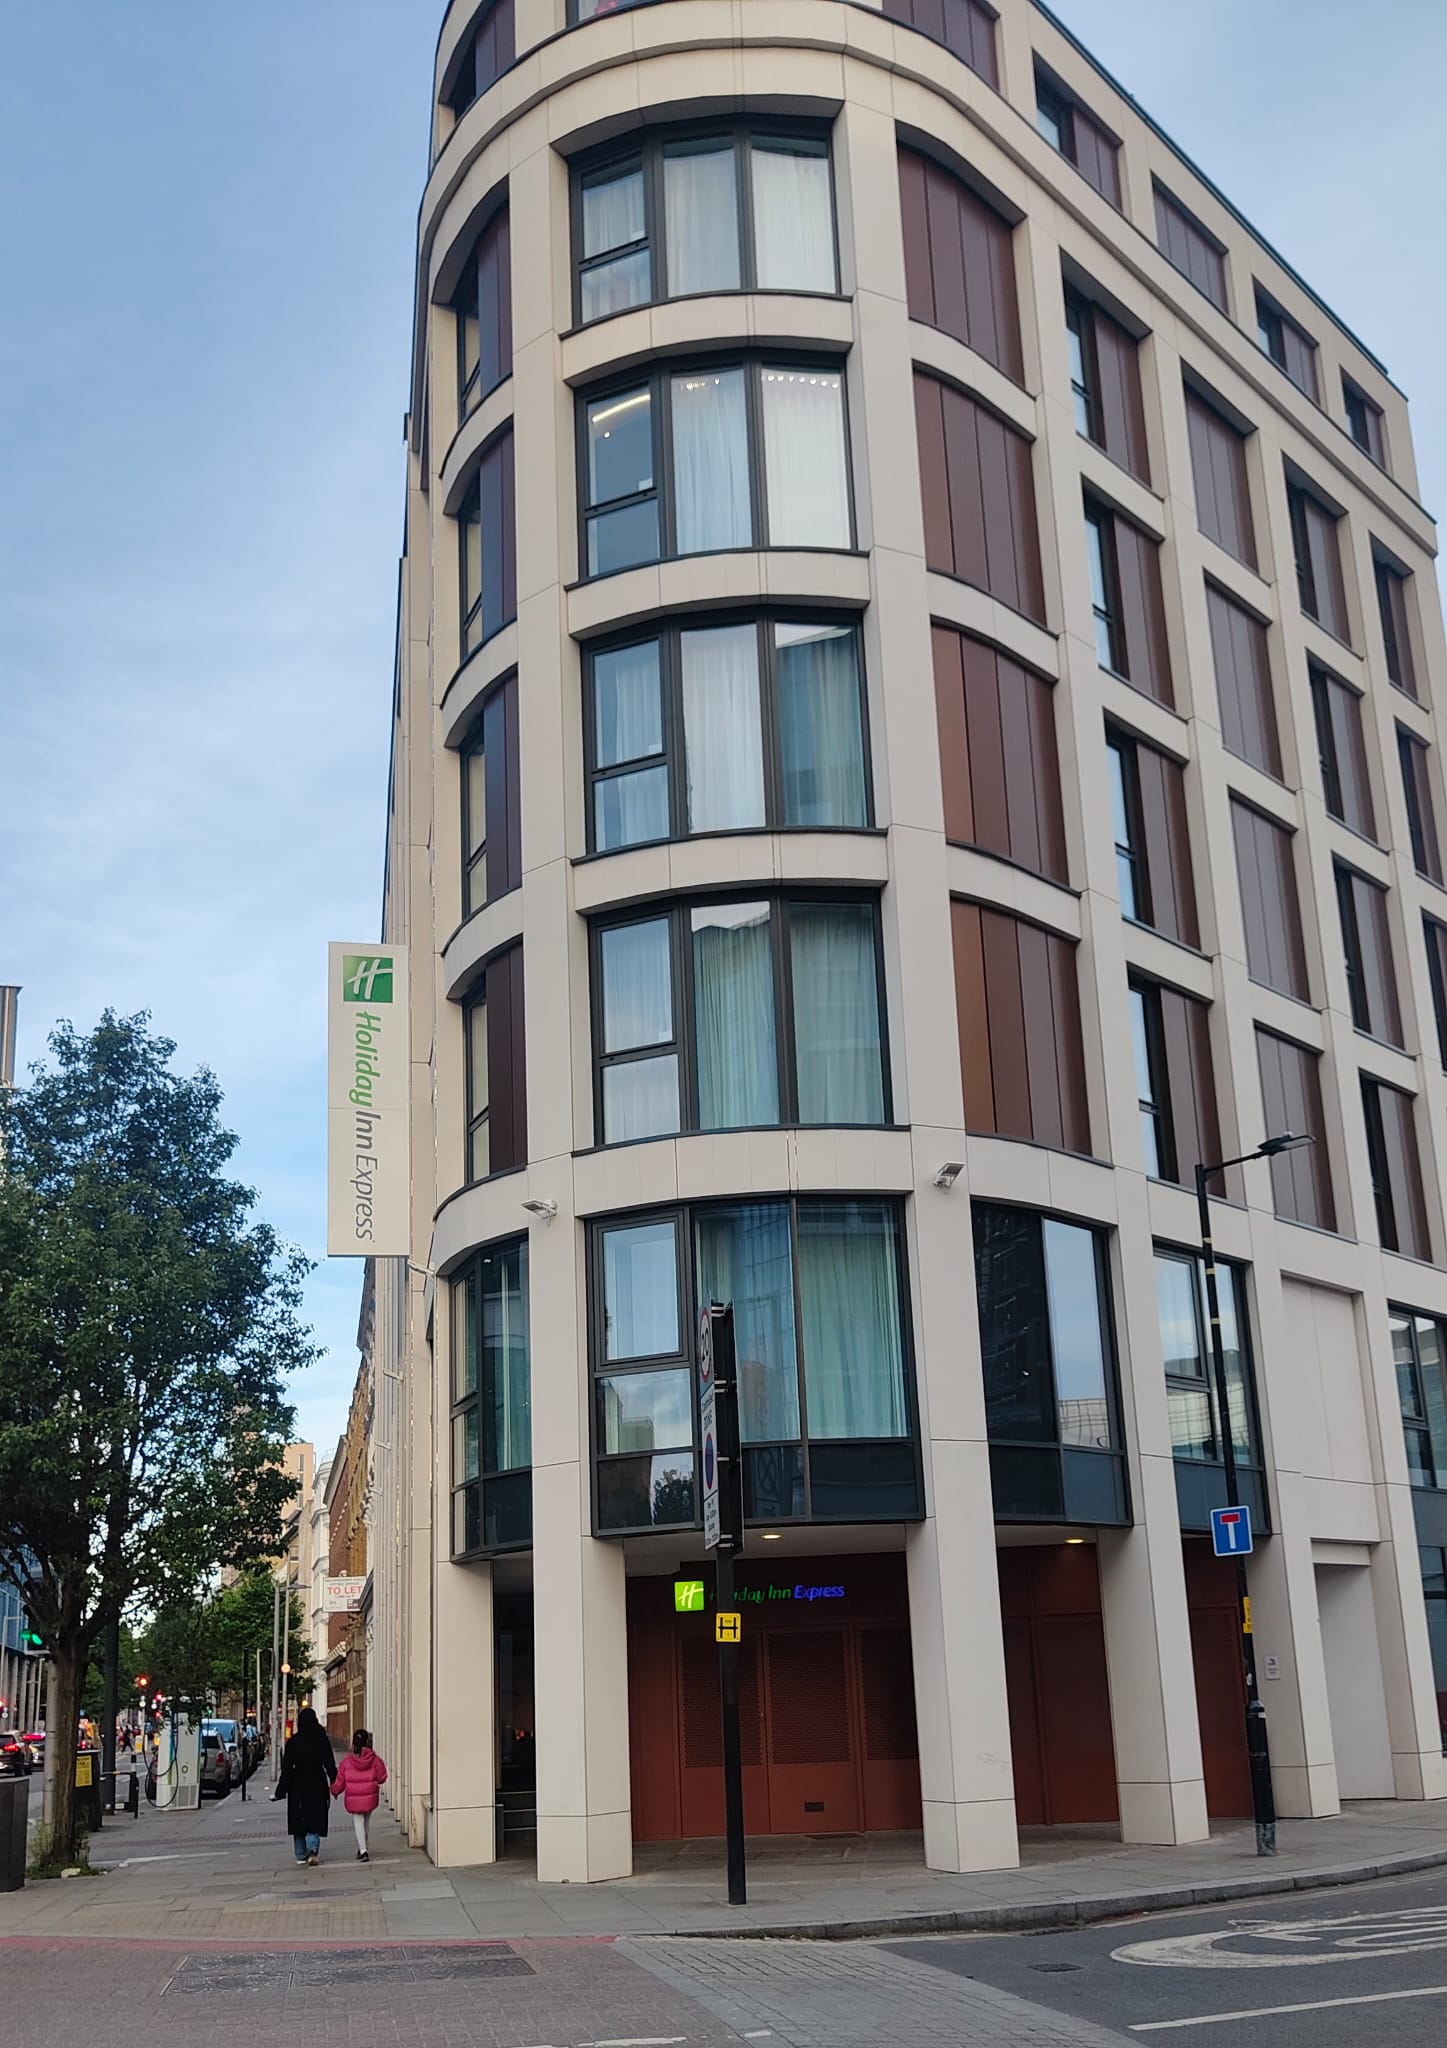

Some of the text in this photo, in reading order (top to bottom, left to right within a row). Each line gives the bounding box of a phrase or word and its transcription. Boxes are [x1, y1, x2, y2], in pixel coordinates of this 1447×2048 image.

[349, 1010, 382, 1241] Holiday Inn Express
[701, 1327, 710, 1362] 20
[327, 1585, 363, 1595] TO LET
[709, 1584, 845, 1604] iday Inn Express
[718, 1617, 739, 1639] H
